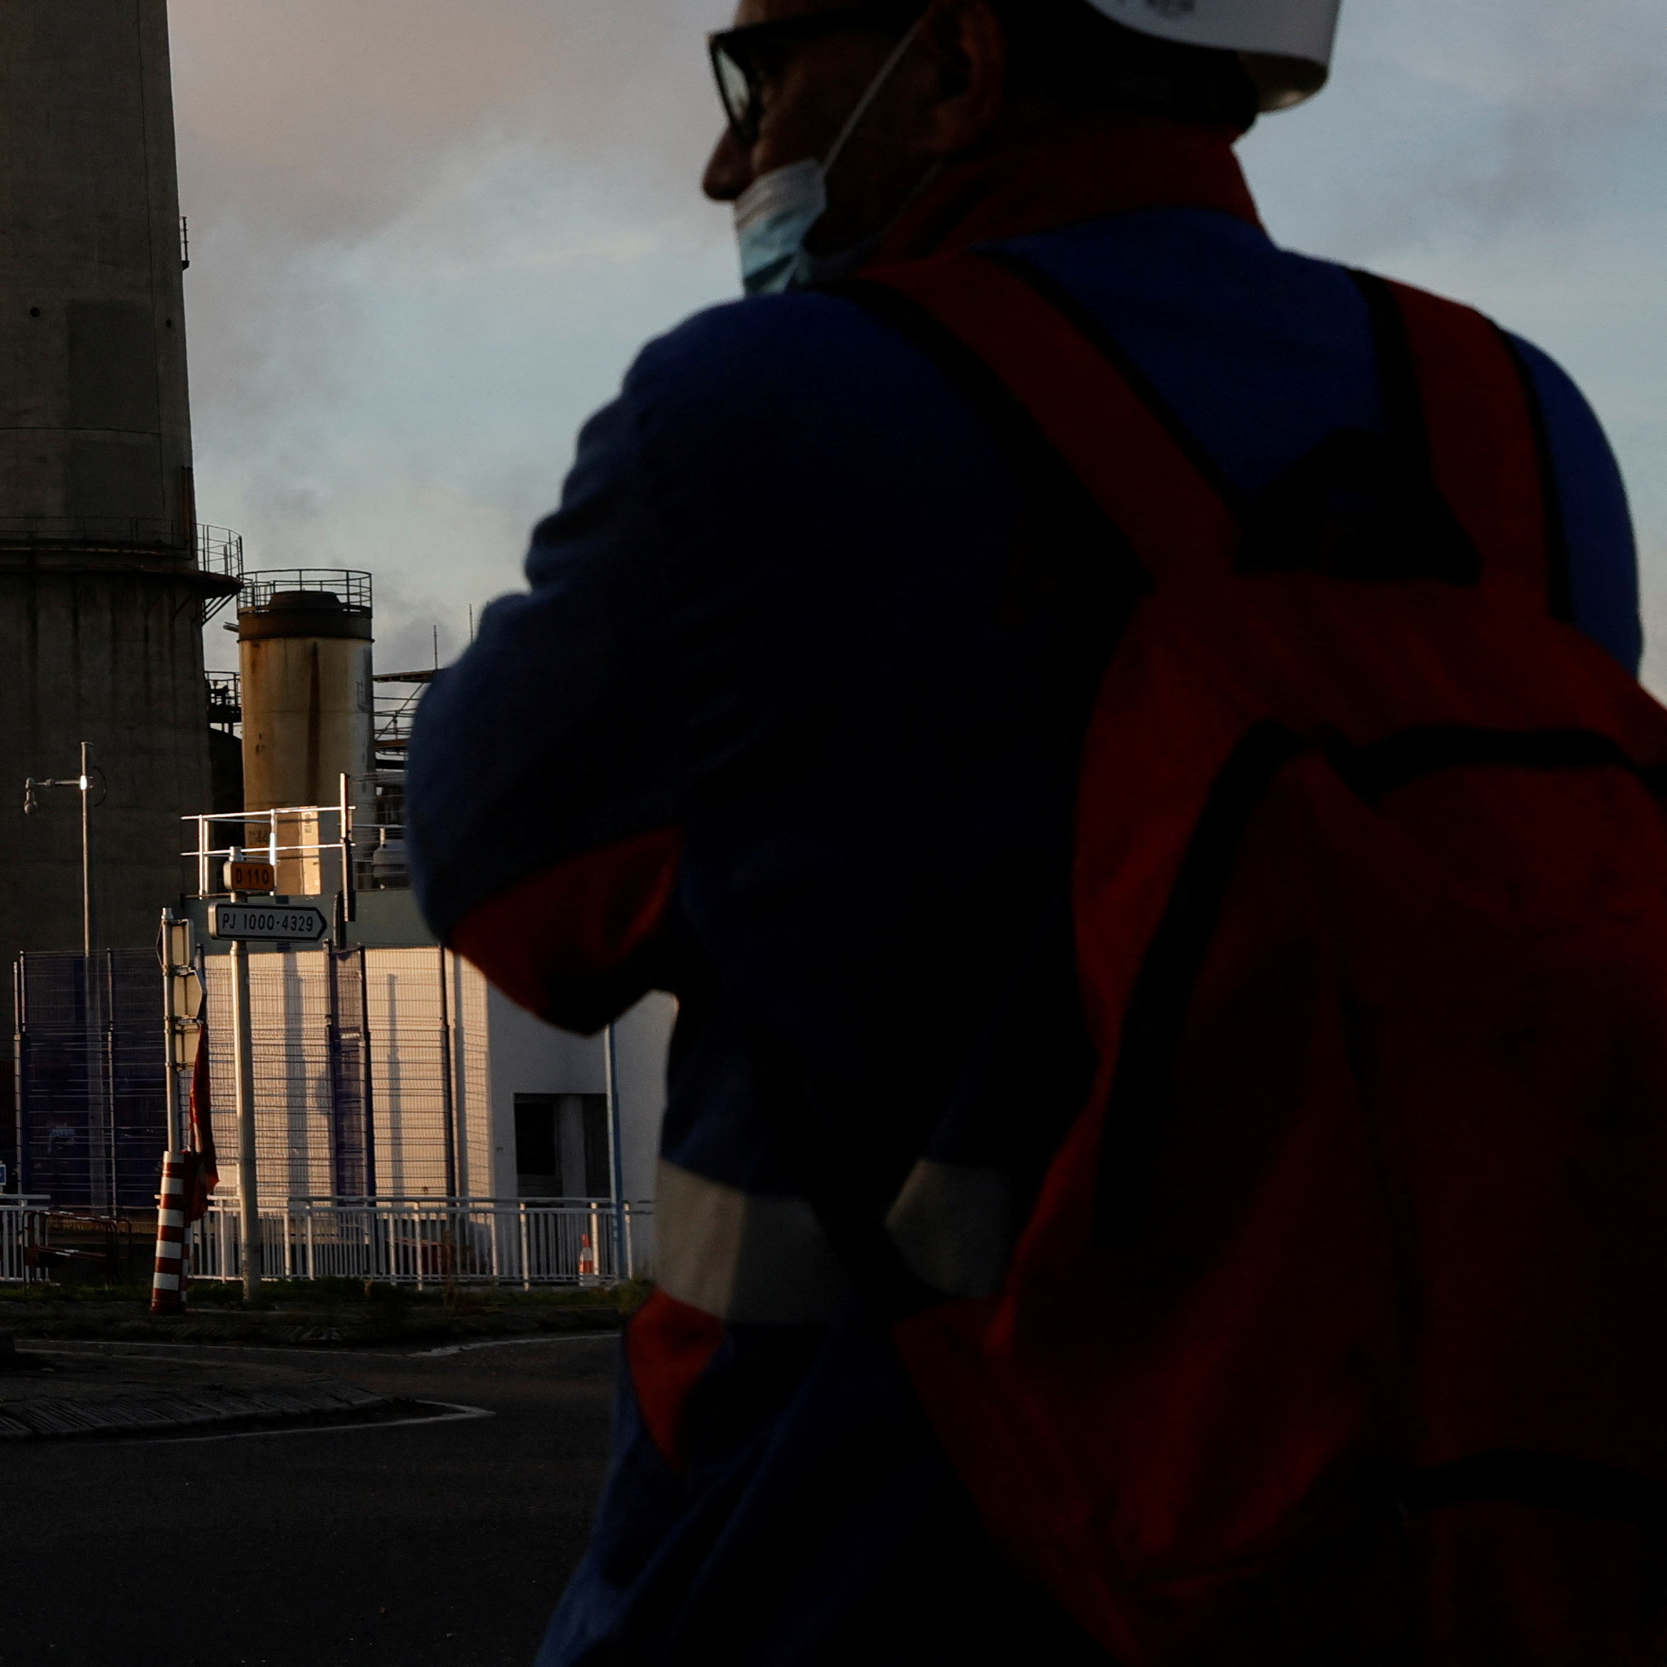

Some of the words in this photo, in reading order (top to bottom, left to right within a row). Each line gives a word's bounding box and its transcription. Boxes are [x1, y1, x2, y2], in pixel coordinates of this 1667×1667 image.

[235, 868, 243, 884] D
[248, 869, 270, 885] 110
[222, 913, 236, 929] PJ
[243, 914, 313, 932] 1000-4329
